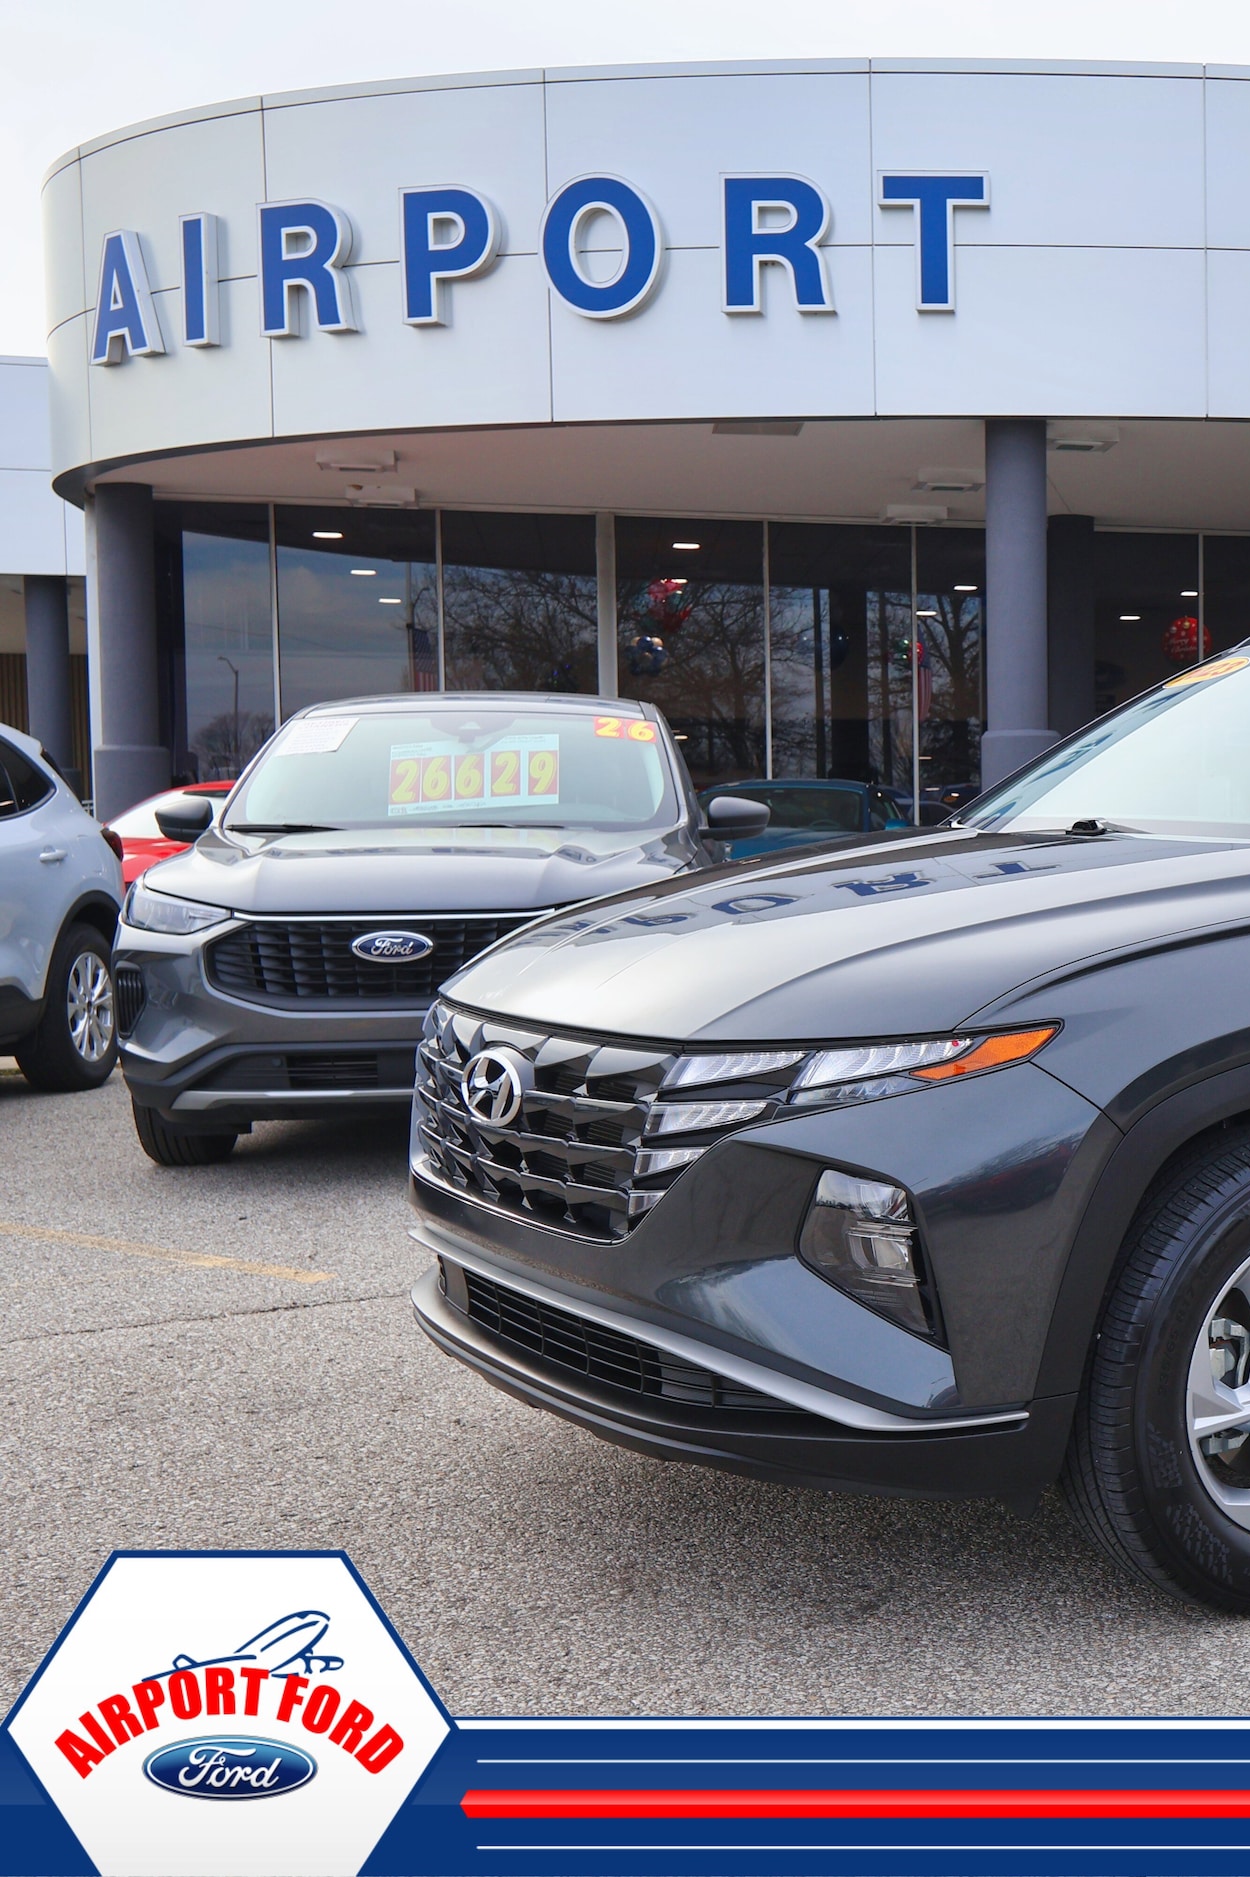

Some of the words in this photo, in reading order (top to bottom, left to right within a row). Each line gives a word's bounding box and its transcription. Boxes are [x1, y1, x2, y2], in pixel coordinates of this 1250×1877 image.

[91, 170, 990, 367] AIRPORT
[595, 717, 655, 741] 26
[391, 751, 557, 803] 26629
[370, 937, 415, 955] Ford
